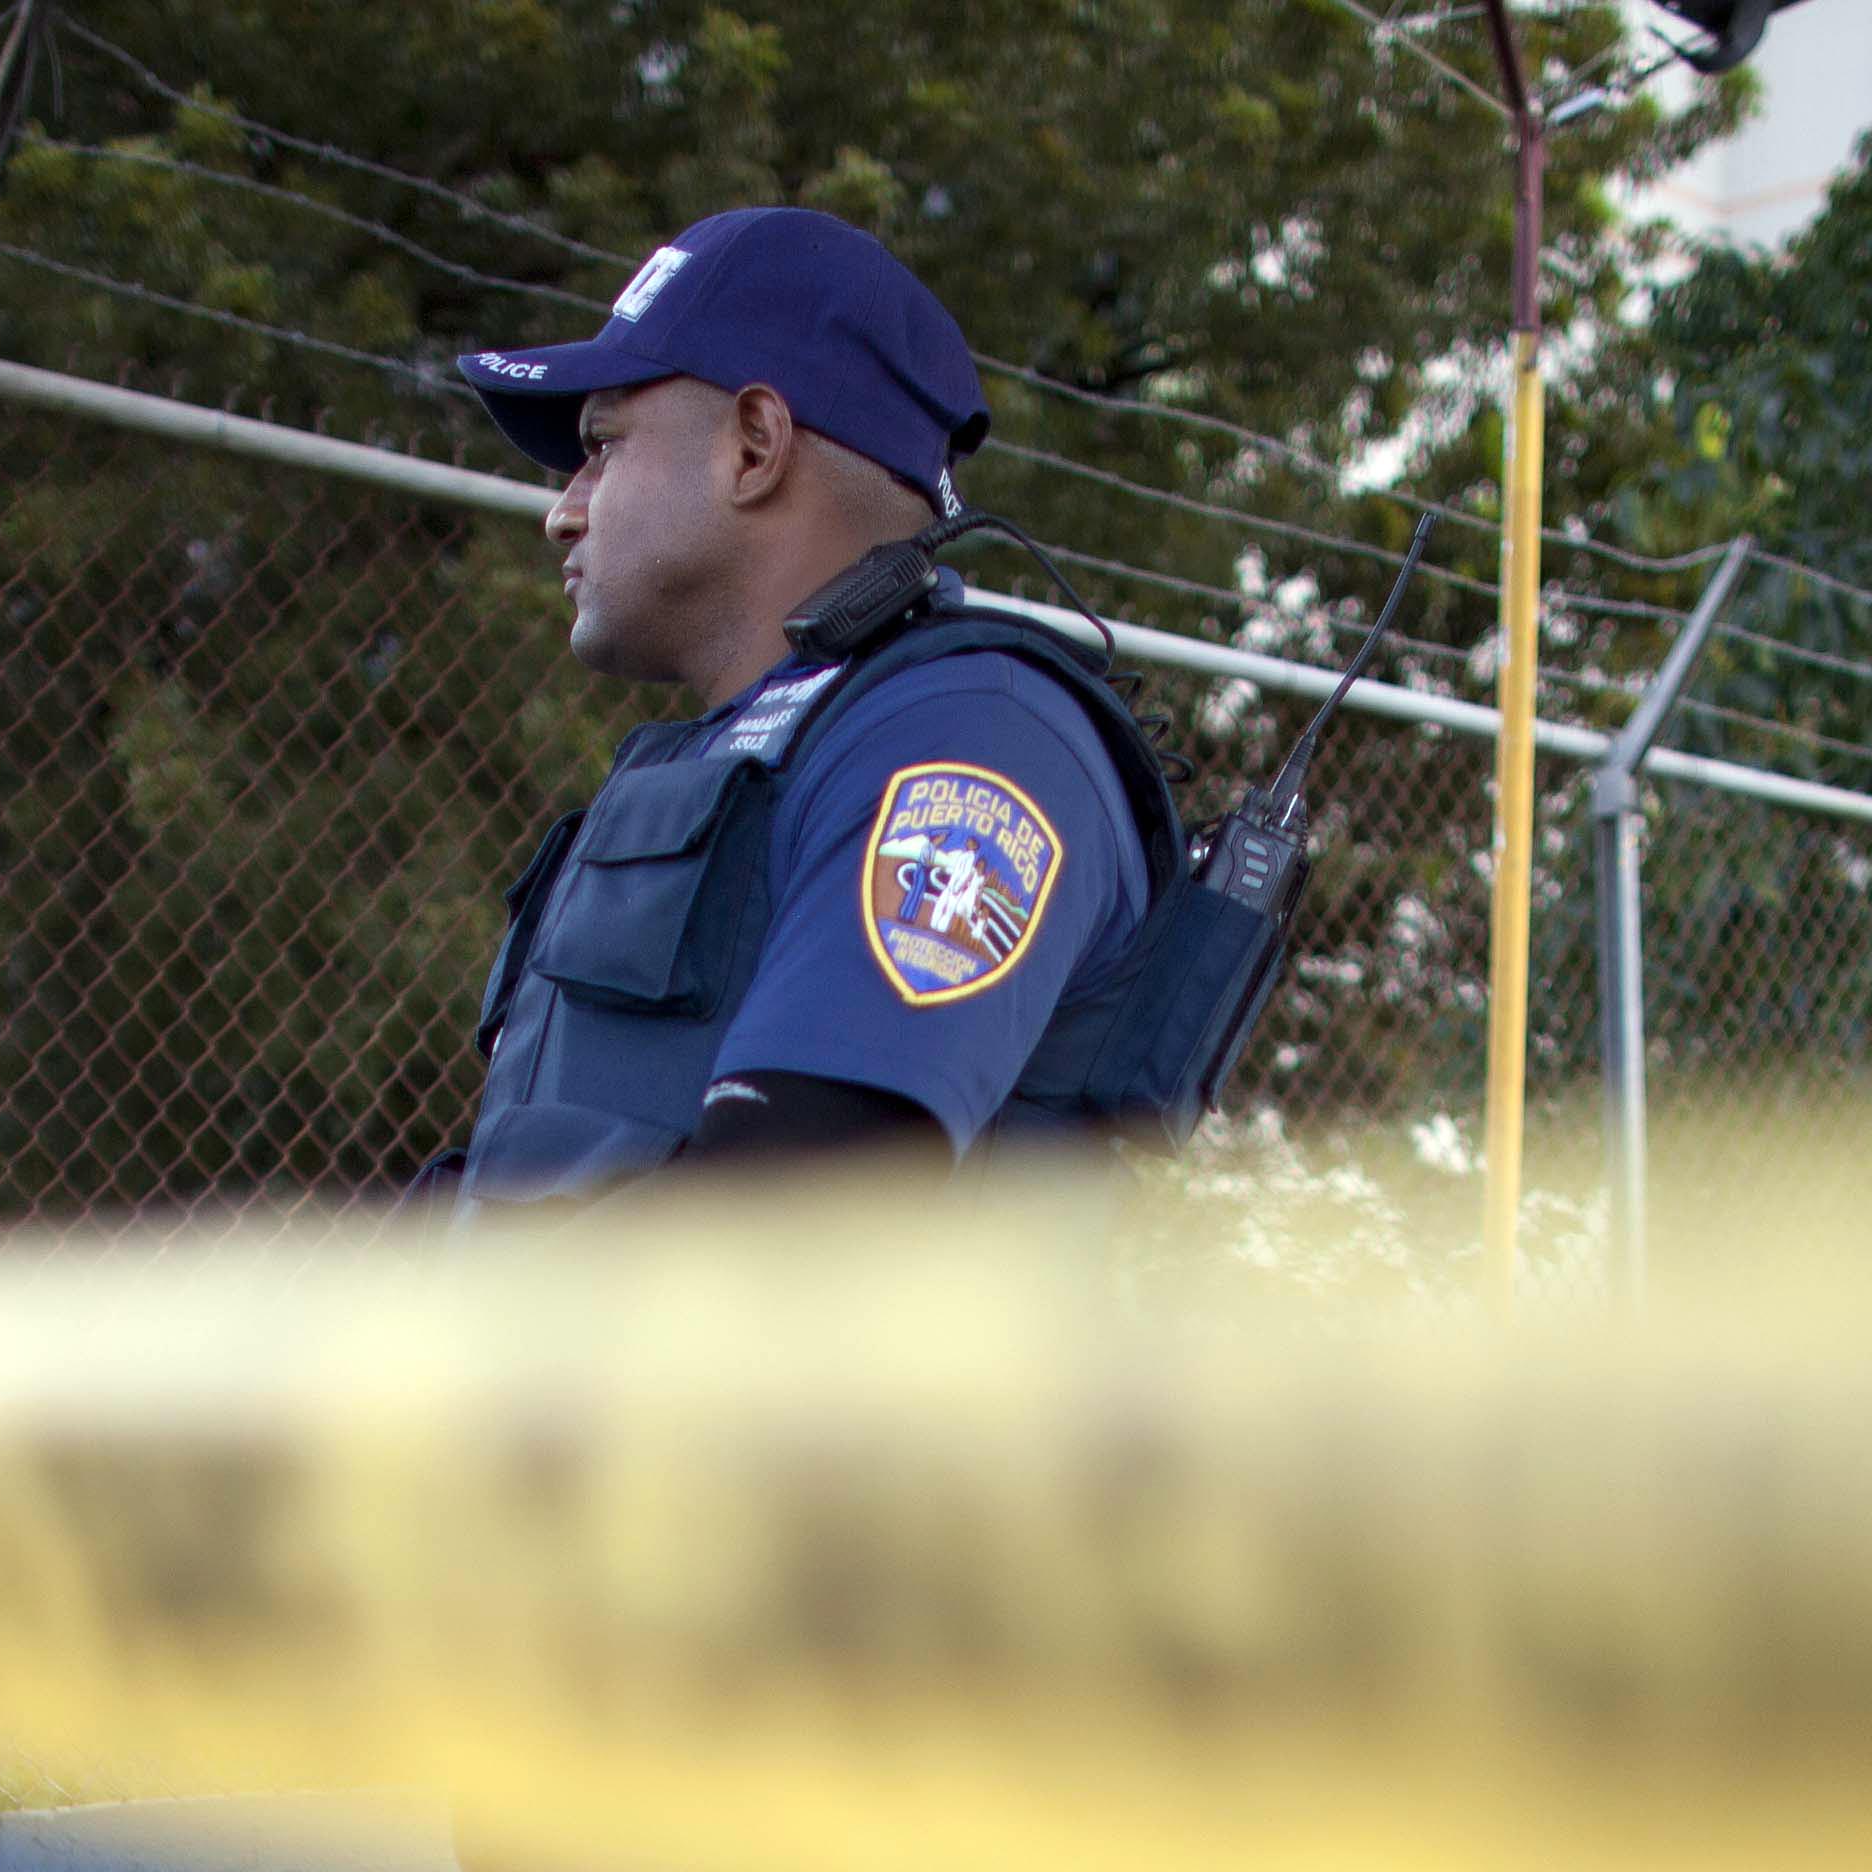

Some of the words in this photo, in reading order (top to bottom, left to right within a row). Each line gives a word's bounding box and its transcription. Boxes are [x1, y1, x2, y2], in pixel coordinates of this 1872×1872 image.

[474, 352, 548, 380] POLICE
[888, 803, 995, 837] PUERTO
[996, 827, 1040, 894] RICO
[907, 779, 1012, 826] POLICIA
[1017, 816, 1045, 854] DE
